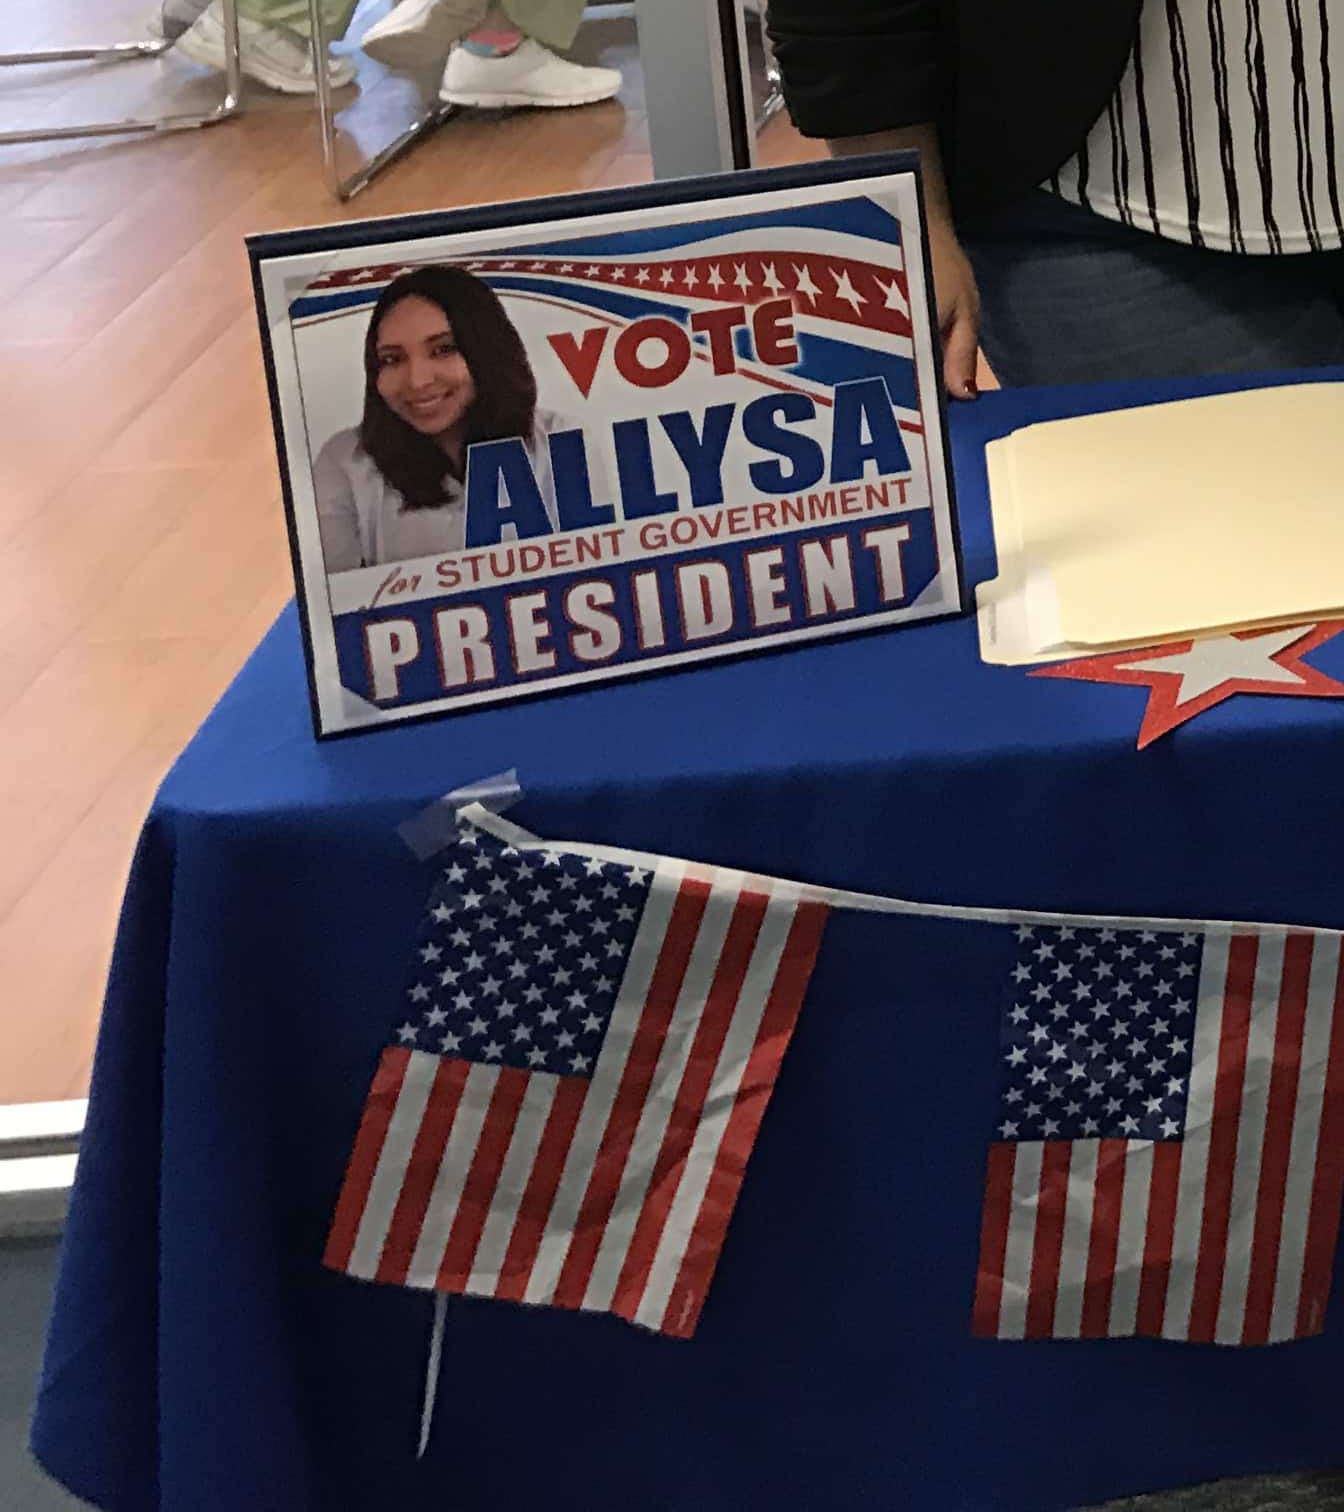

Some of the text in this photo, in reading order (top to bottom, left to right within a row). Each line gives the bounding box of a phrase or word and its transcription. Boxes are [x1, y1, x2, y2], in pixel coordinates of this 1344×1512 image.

[546, 296, 800, 399] VOTE
[464, 375, 912, 550] ALLYSA
[359, 478, 913, 613] for STUDENT GOVERNMENT
[363, 522, 913, 702] PRESIDENT
